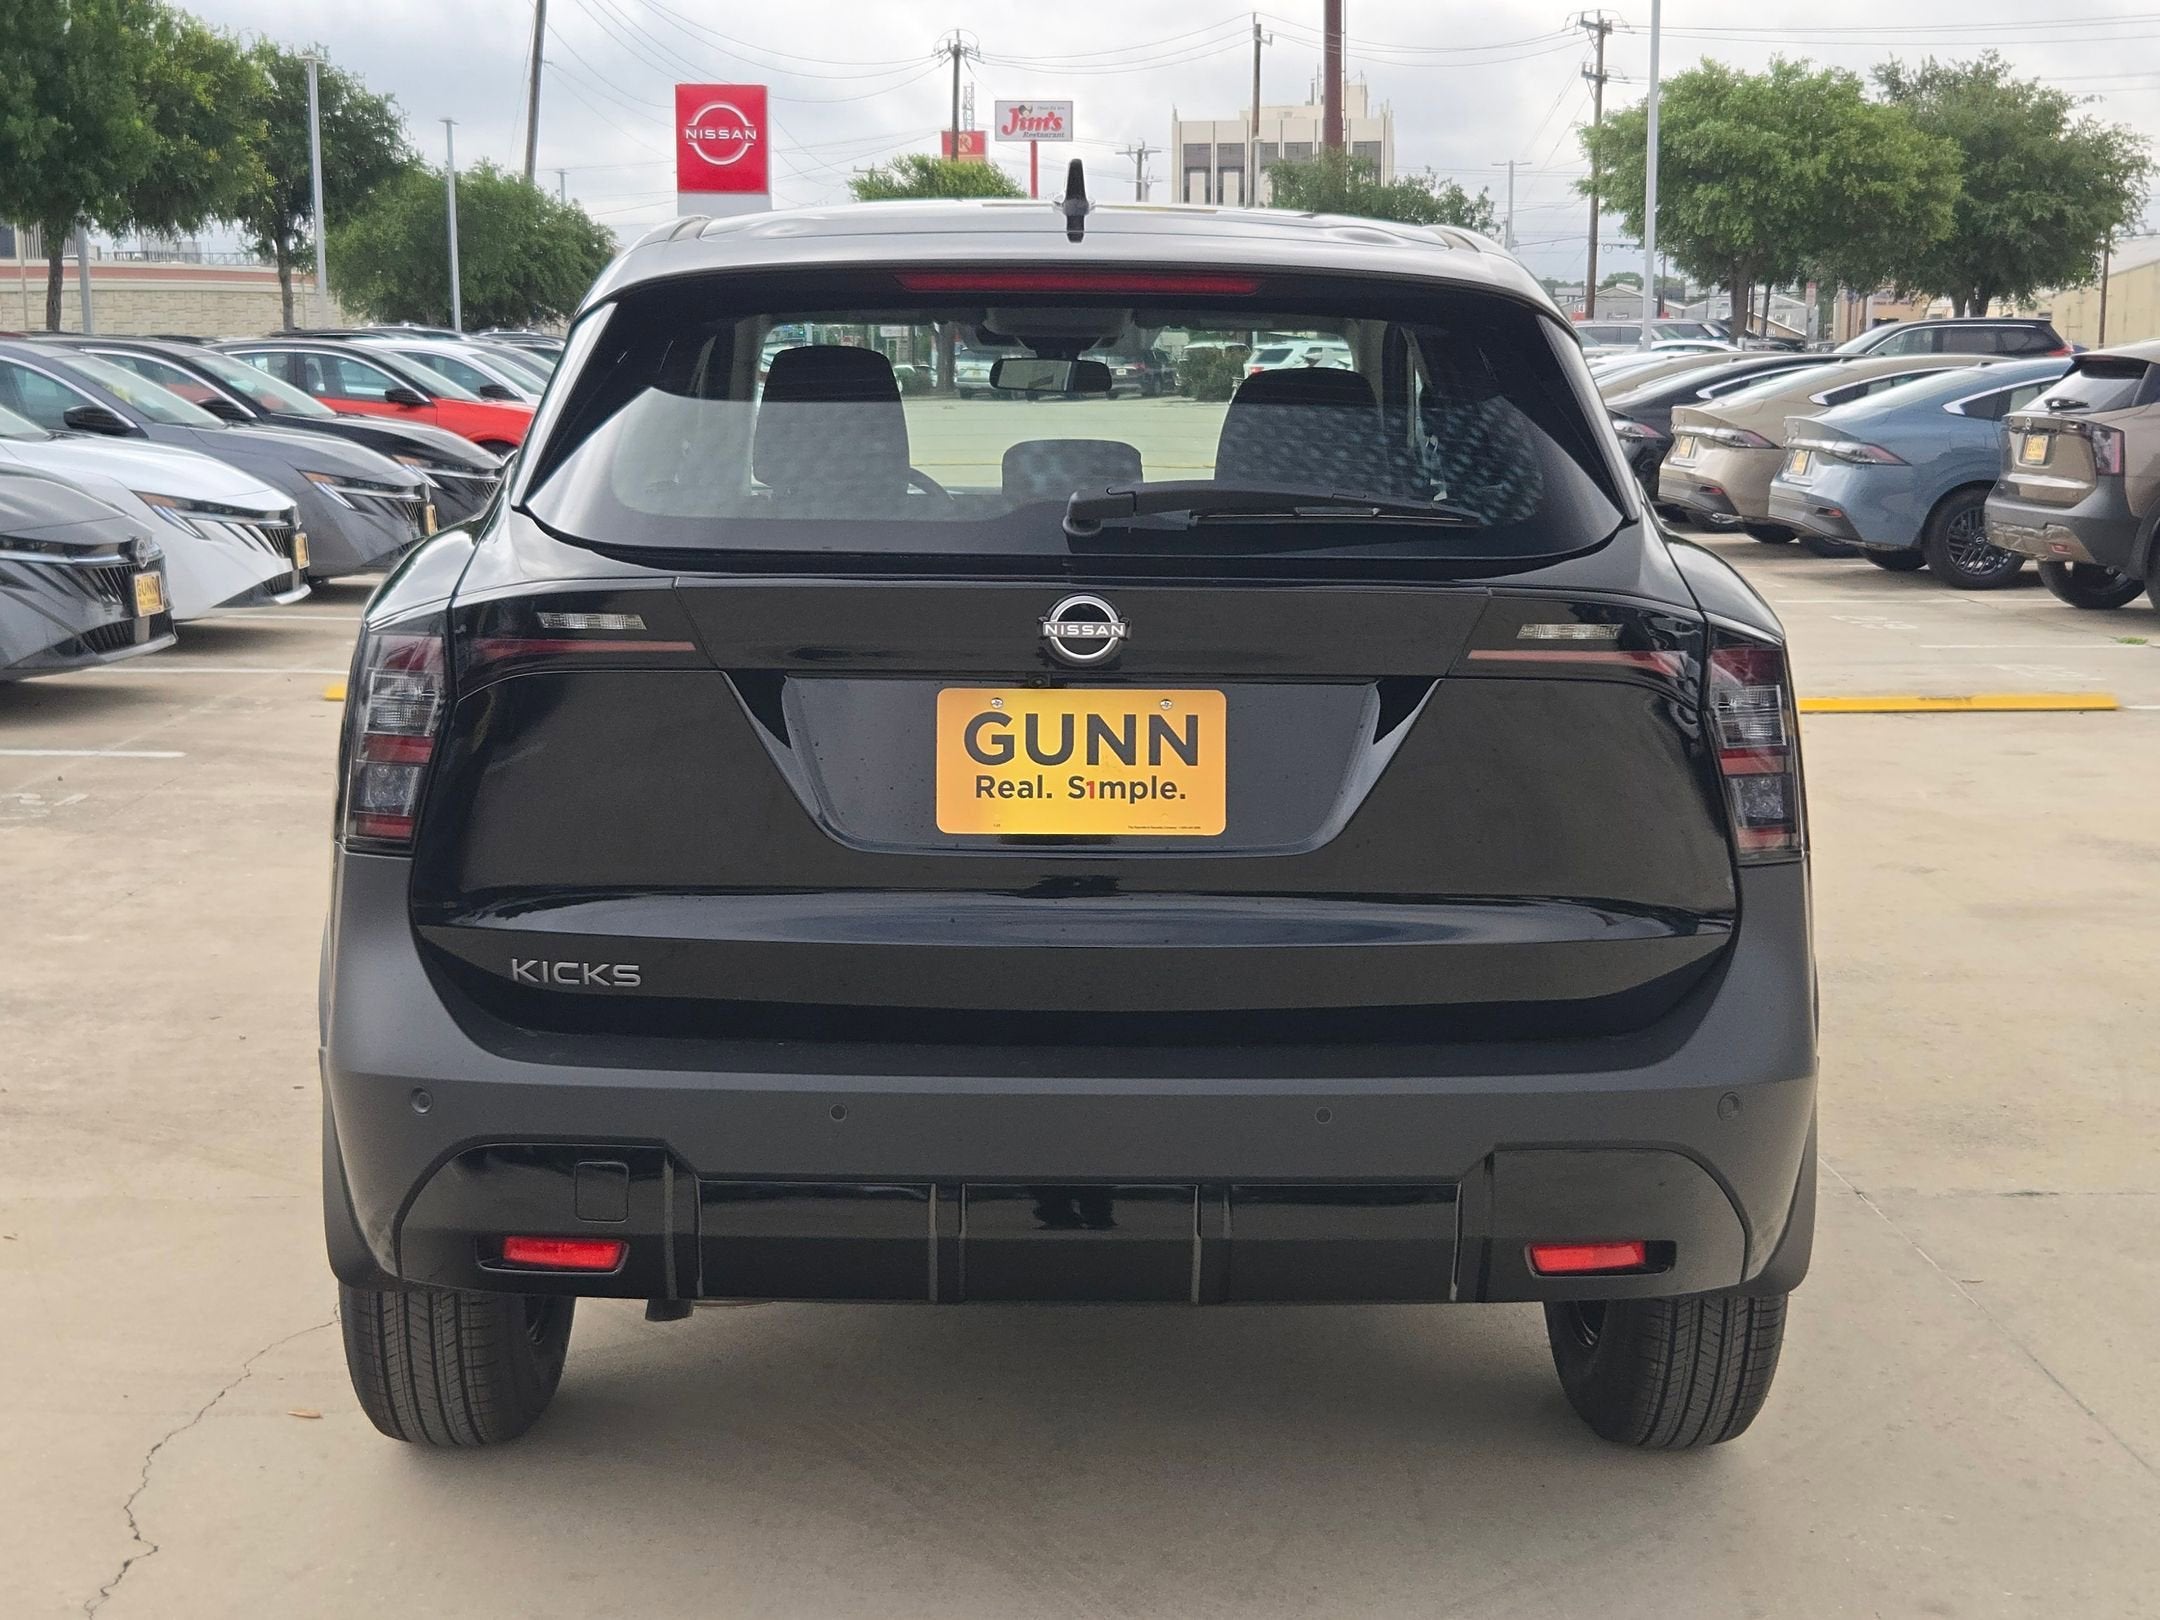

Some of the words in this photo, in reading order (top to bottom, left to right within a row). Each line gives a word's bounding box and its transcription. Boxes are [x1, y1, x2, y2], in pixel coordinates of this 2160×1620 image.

[1001, 106, 1063, 136] Jim's
[685, 128, 757, 141] NISSAN
[1022, 131, 1065, 139] Restaurant
[1044, 623, 1126, 637] NISSAN
[963, 711, 1199, 767] GUNN
[975, 775, 1054, 800] Real.
[511, 958, 643, 988] KICKS
